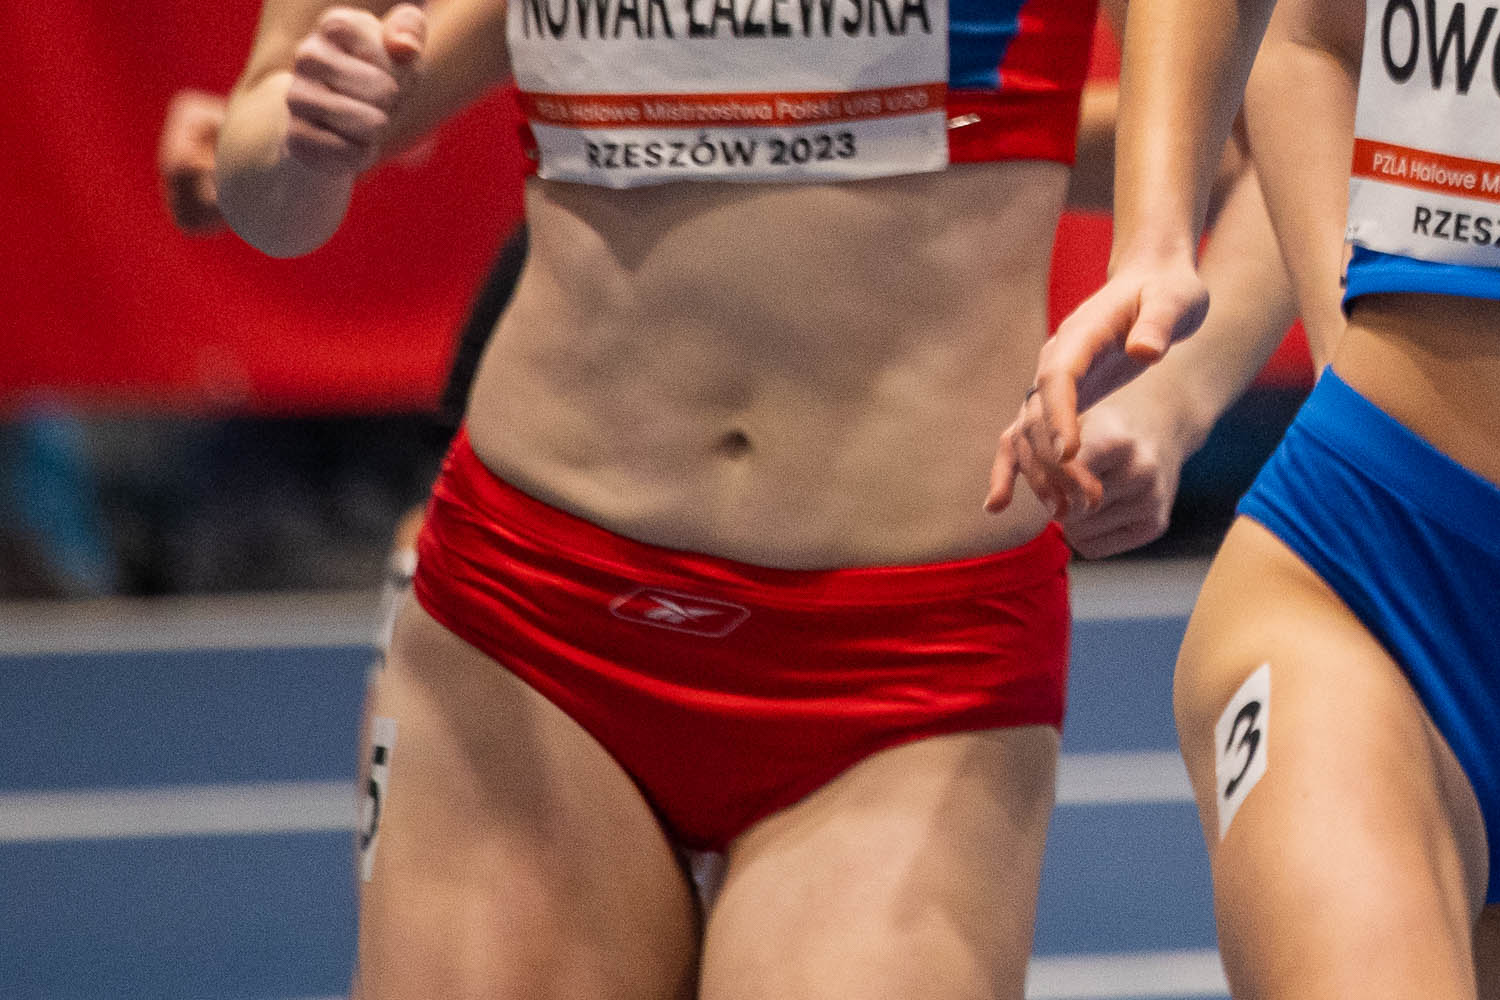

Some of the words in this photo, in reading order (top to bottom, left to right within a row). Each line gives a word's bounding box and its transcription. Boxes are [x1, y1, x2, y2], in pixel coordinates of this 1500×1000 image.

[586, 130, 756, 168] RZESZÓW
[768, 131, 855, 165] 2023
[1372, 152, 1407, 177] PZLA
[1409, 161, 1477, 190] Halowe
[1223, 699, 1262, 801] 3
